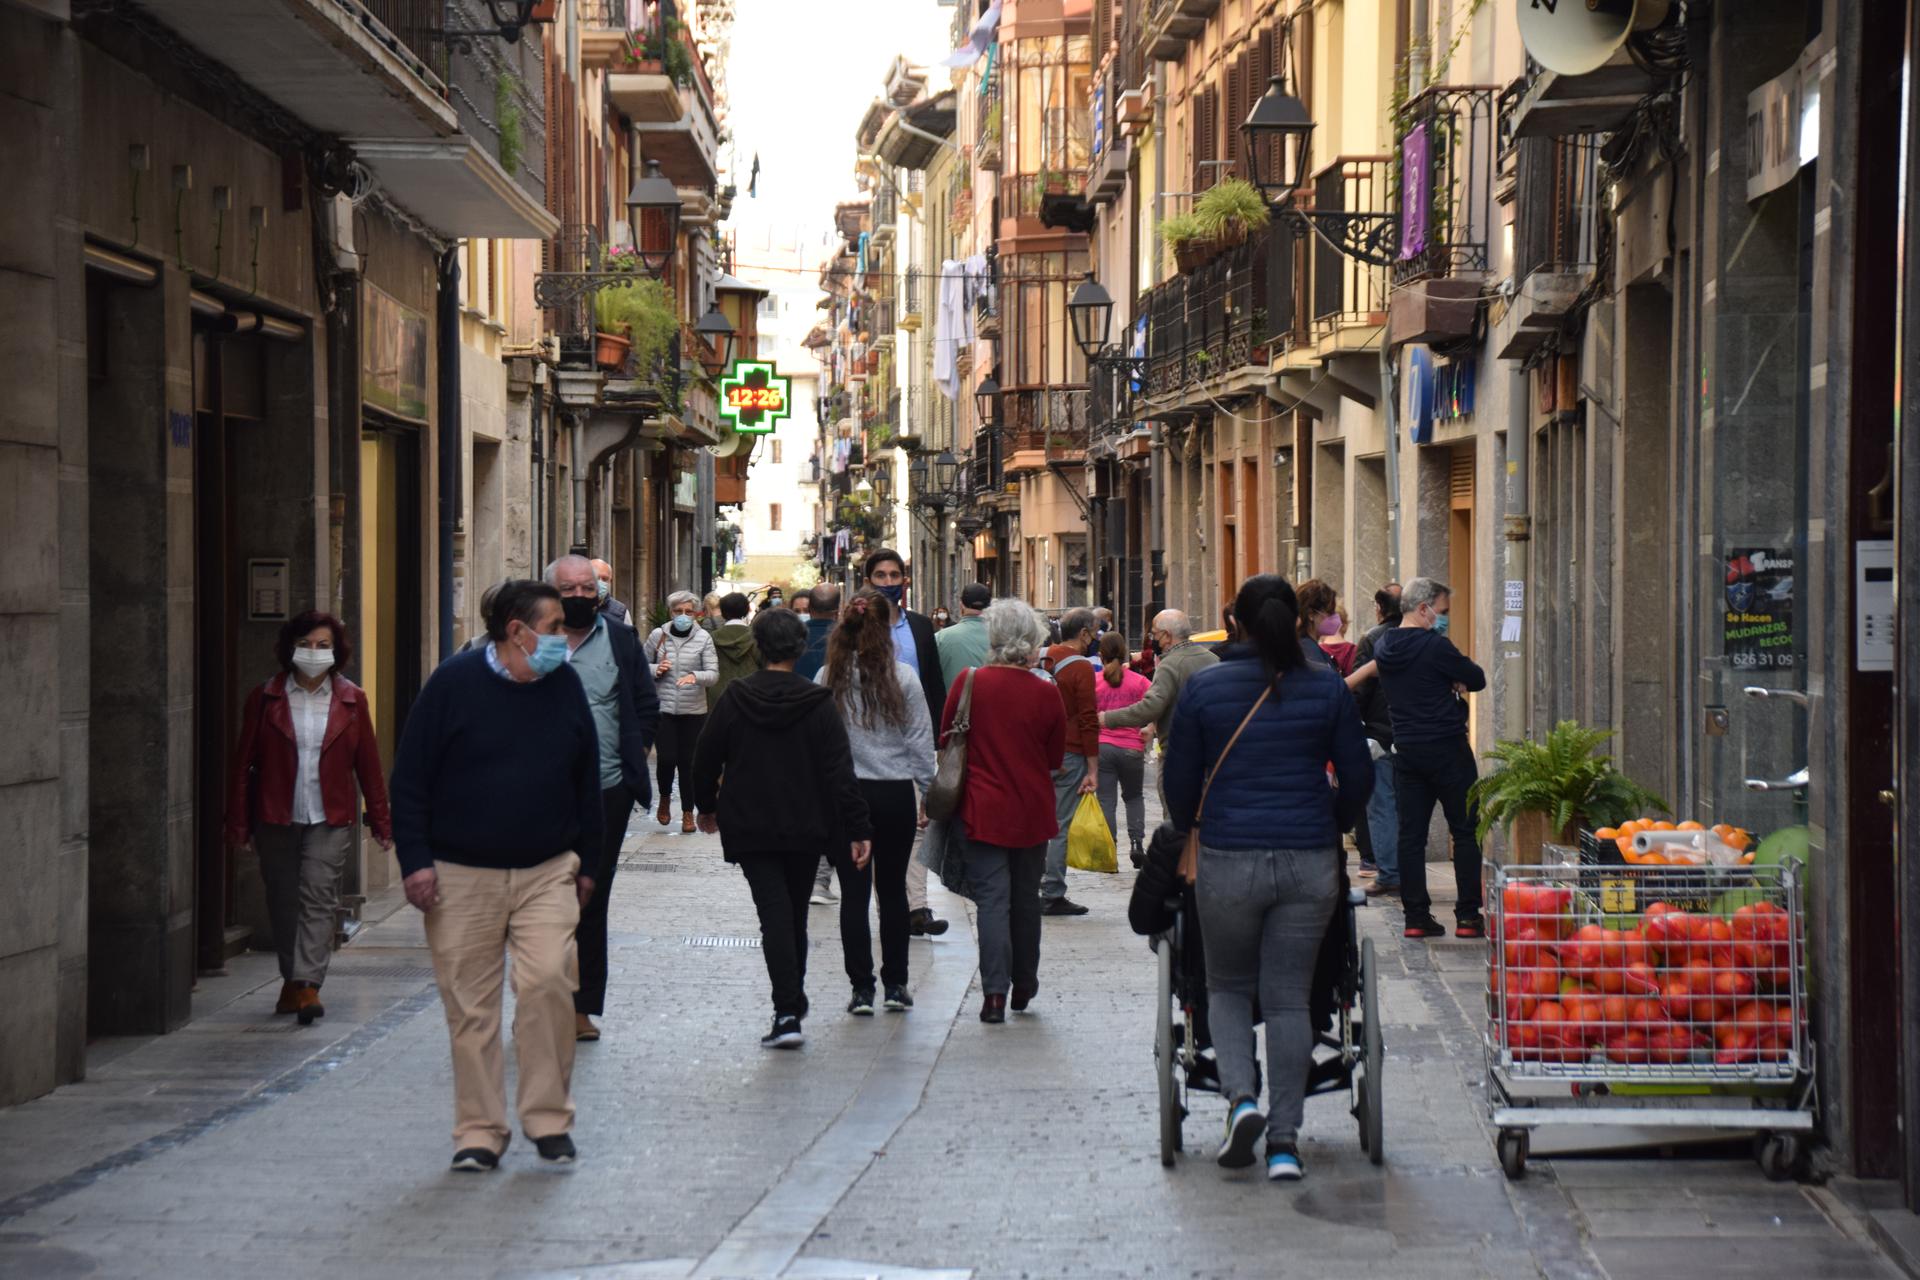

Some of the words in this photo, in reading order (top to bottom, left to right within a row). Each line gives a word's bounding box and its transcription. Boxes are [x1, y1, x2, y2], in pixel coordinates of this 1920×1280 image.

[730, 388, 780, 406] 12:26
[1727, 612, 1740, 622] Se
[1741, 613, 1772, 623] Hacen
[1725, 622, 1787, 640] MUDANZAS
[1733, 653, 1756, 665] 626
[1759, 653, 1773, 665] 31
